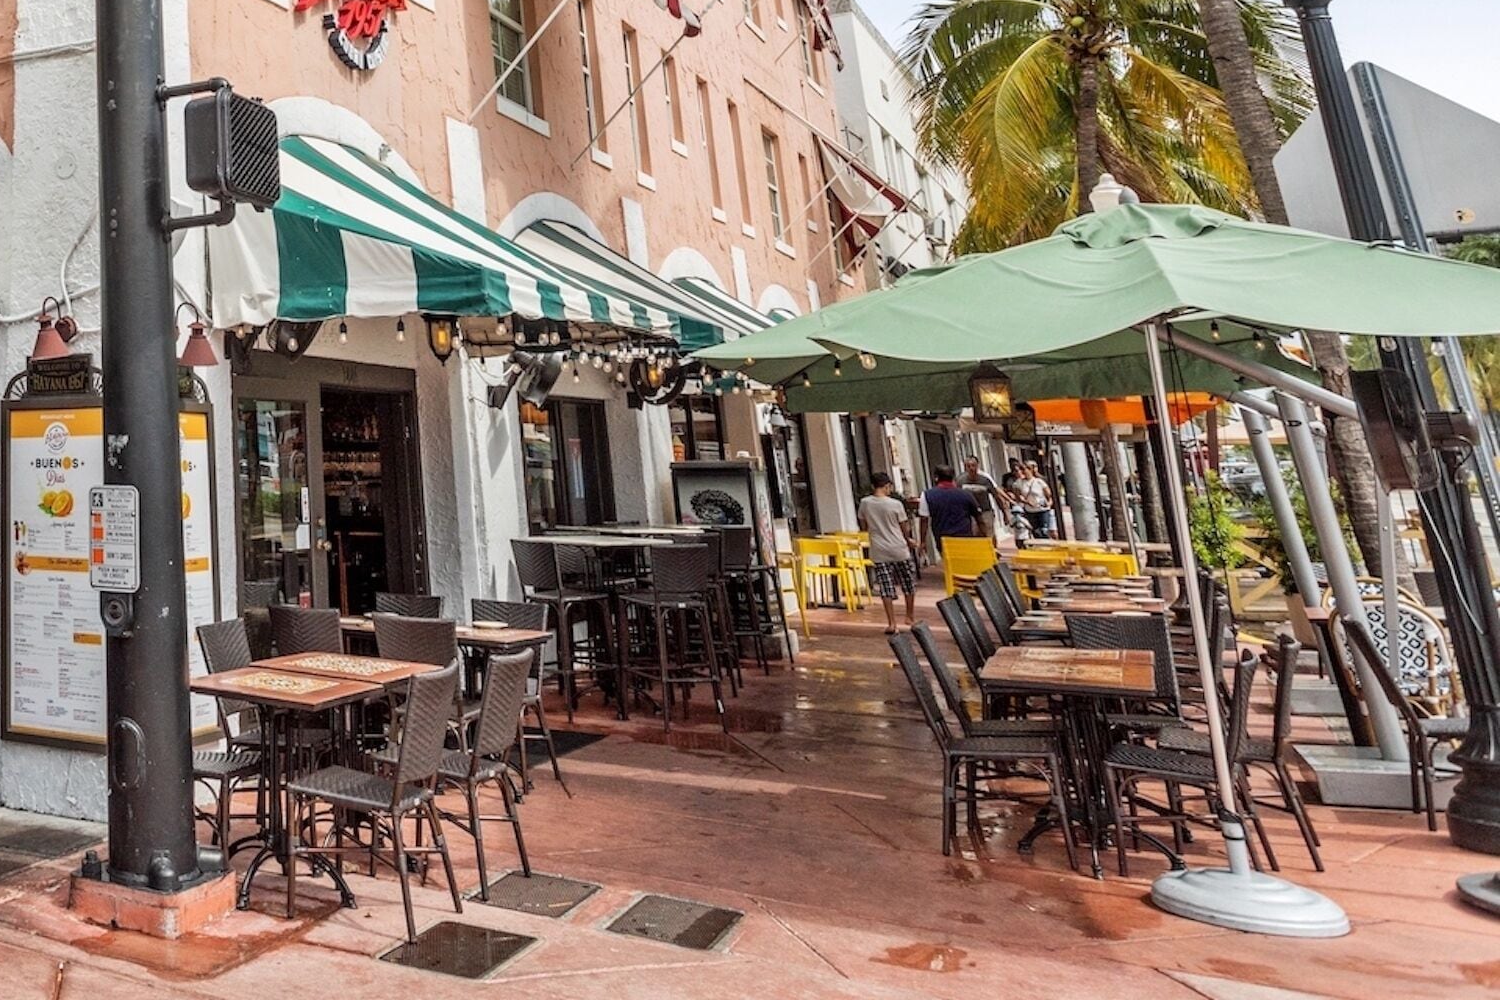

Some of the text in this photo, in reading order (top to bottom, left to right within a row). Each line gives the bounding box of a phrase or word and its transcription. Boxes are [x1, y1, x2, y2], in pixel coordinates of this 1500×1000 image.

[338, 0, 388, 40] 1957
[32, 373, 68, 392] HAVANA
[35, 457, 79, 470] BUENOS
